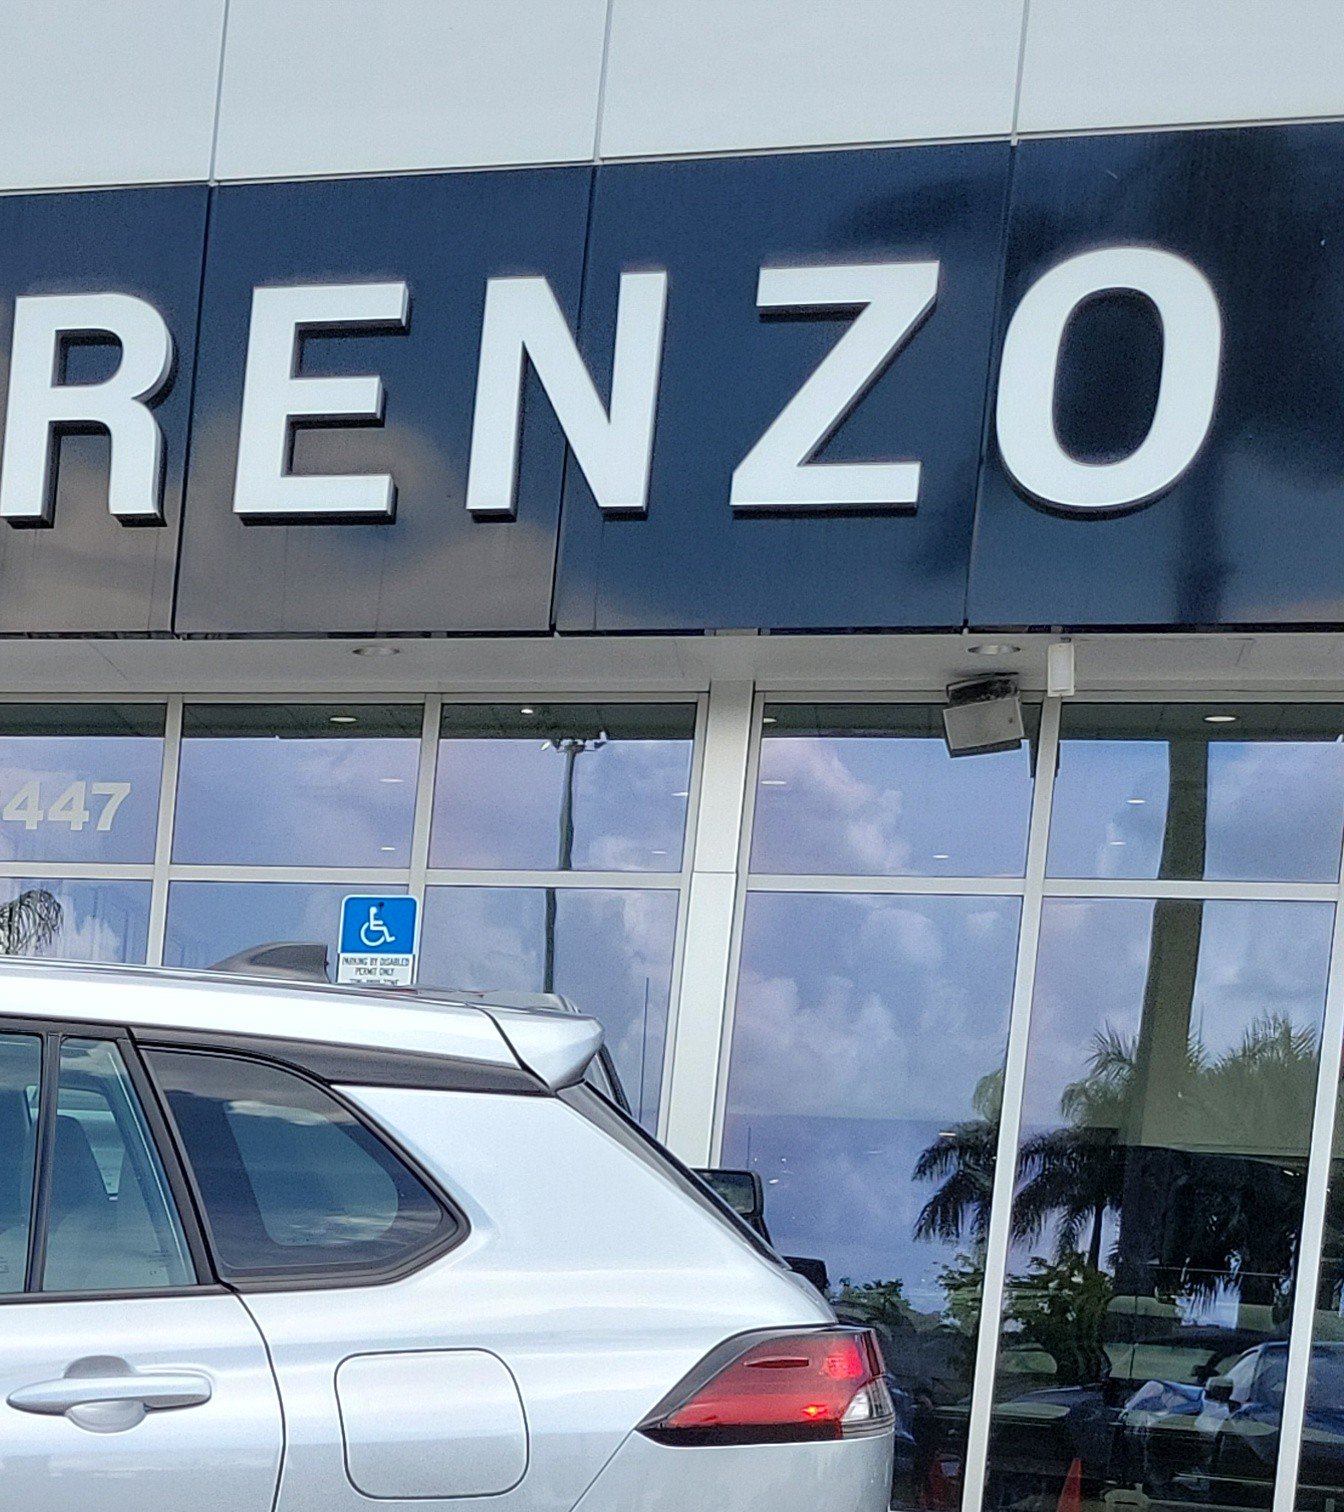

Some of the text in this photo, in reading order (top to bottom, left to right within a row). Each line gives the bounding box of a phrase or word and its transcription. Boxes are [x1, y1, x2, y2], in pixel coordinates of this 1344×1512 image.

[342, 956, 410, 967] PARKING BY DISABLED
[355, 967, 395, 976] PERMIT ONLY
